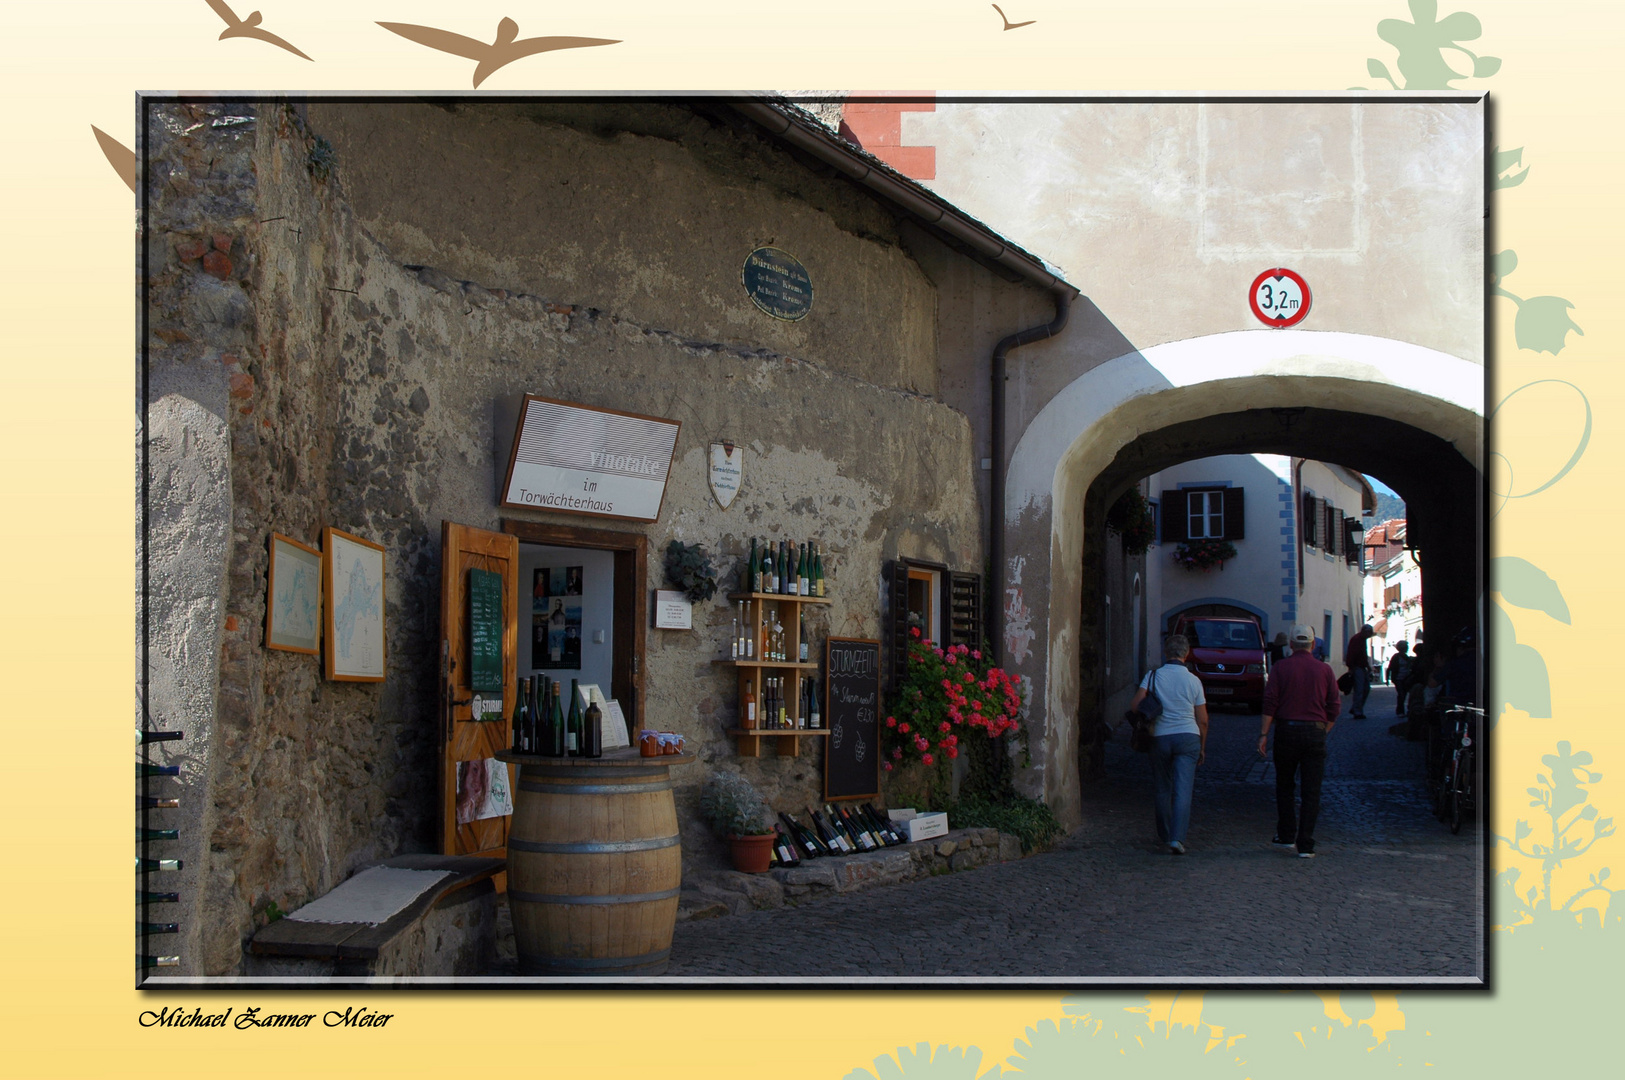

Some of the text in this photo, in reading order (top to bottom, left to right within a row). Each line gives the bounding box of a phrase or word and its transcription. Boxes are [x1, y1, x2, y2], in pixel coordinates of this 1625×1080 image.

[752, 256, 789, 276] Dürnstein
[782, 279, 803, 294] Krems
[782, 291, 804, 306] Krems
[590, 450, 660, 475] vinotake
[583, 477, 598, 493] im
[520, 488, 613, 512] Torwächterhaus
